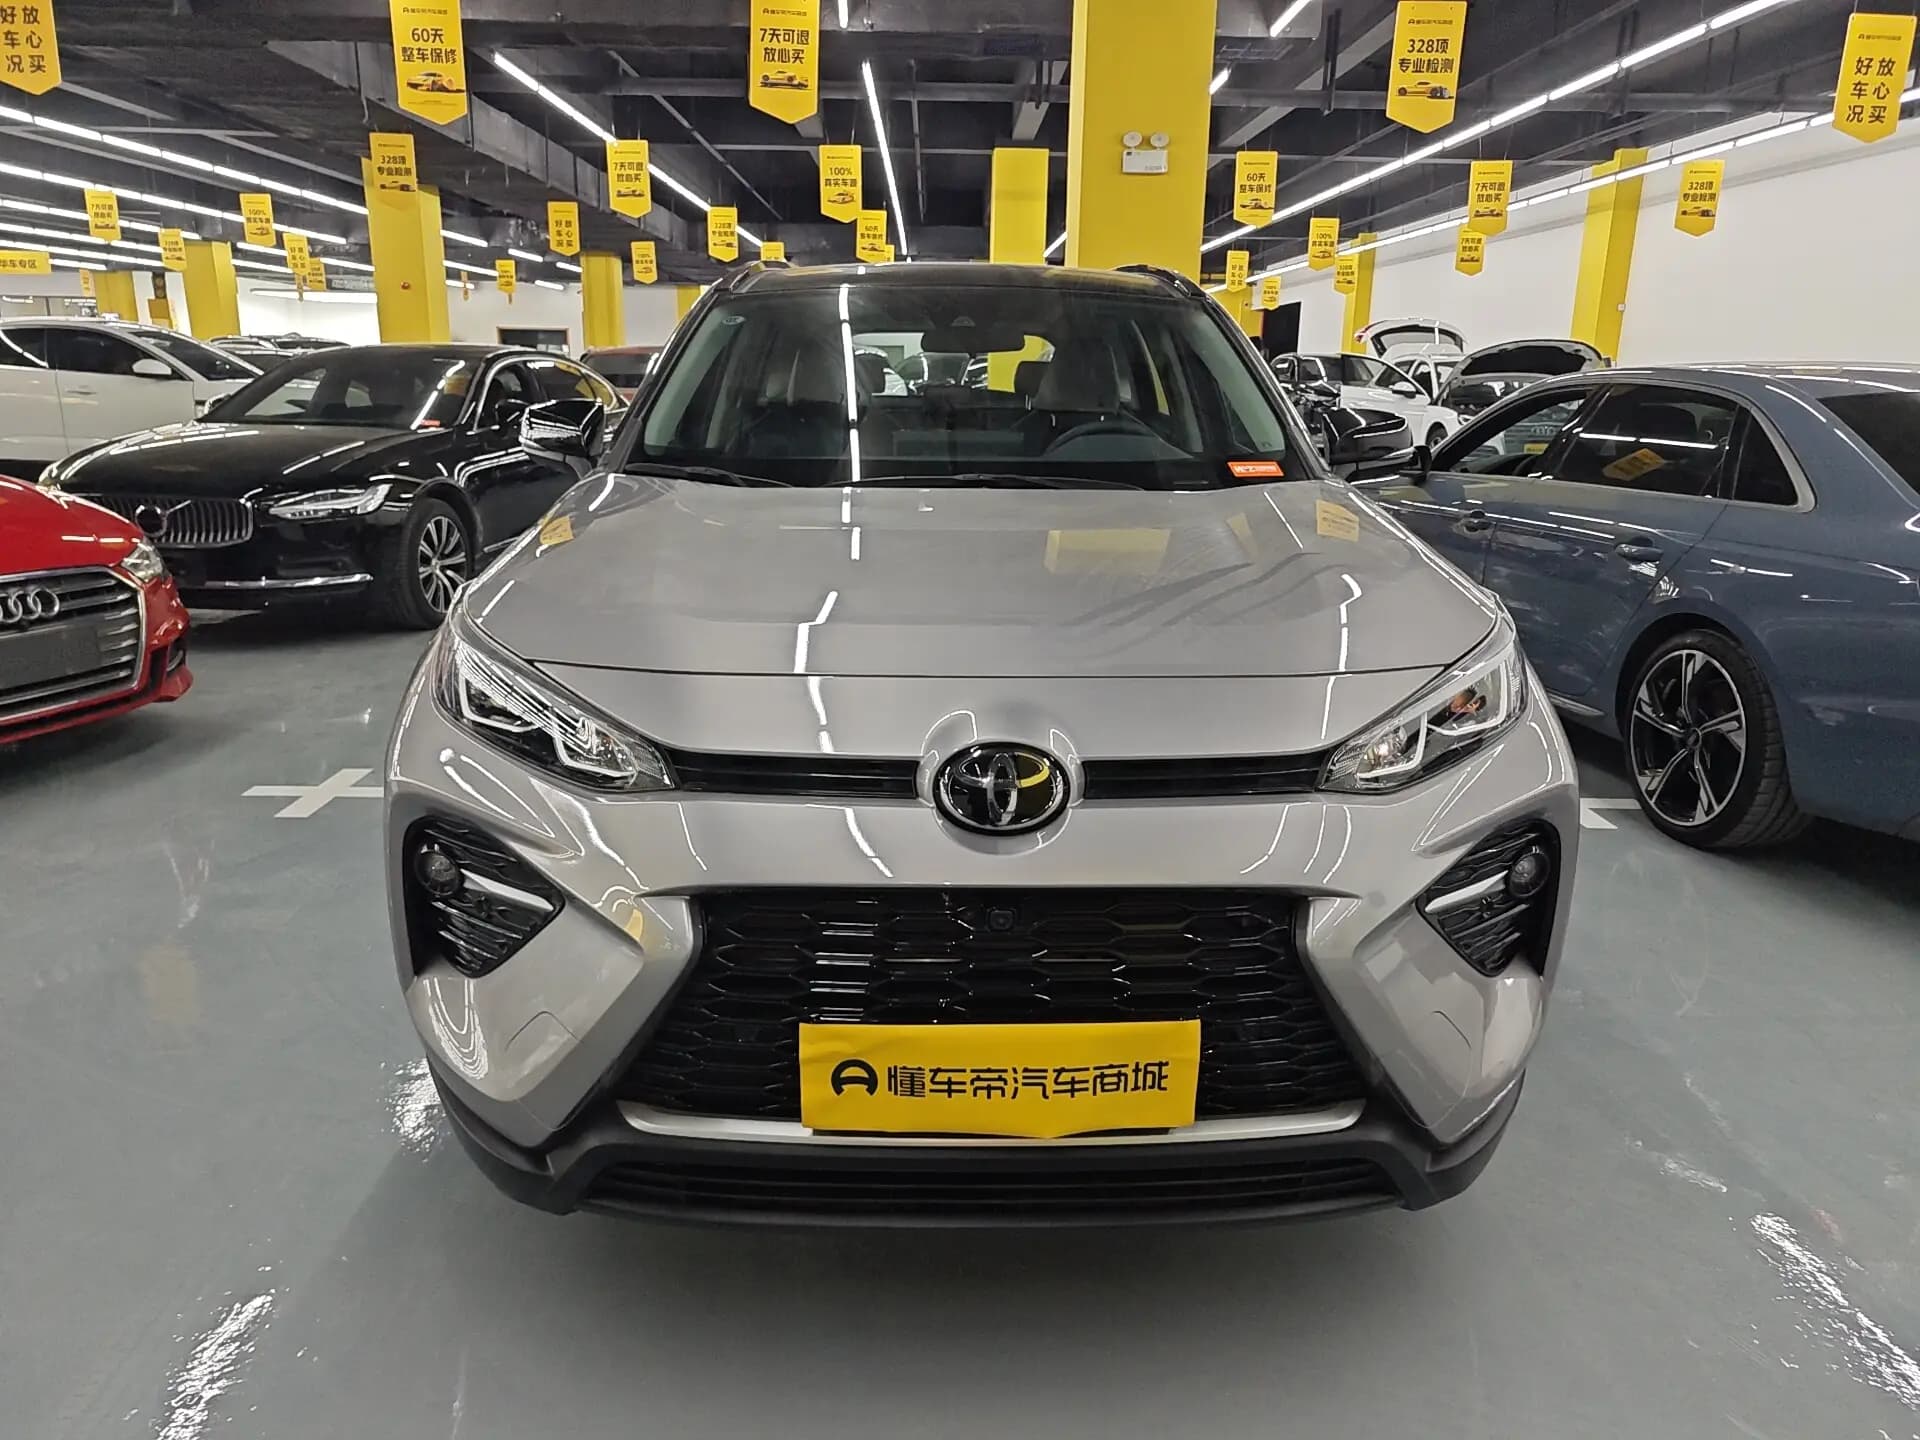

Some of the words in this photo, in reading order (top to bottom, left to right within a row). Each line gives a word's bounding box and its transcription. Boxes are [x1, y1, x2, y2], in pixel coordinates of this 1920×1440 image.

[0, 5, 24, 73] 好车况
[21, 5, 46, 73] 放心买
[411, 28, 444, 44] 60天
[760, 28, 809, 45] 7天可退
[1407, 38, 1449, 54] 328项
[401, 46, 457, 64] 整车保修
[763, 47, 805, 64] 放心买
[1399, 57, 1454, 74] 专业检测
[1846, 56, 1874, 123] 好车况
[1868, 57, 1896, 124] 放心买
[829, 167, 852, 176] 100%
[1246, 173, 1266, 182] 60天
[887, 1061, 1170, 1100] 懂车帝汽车商城
